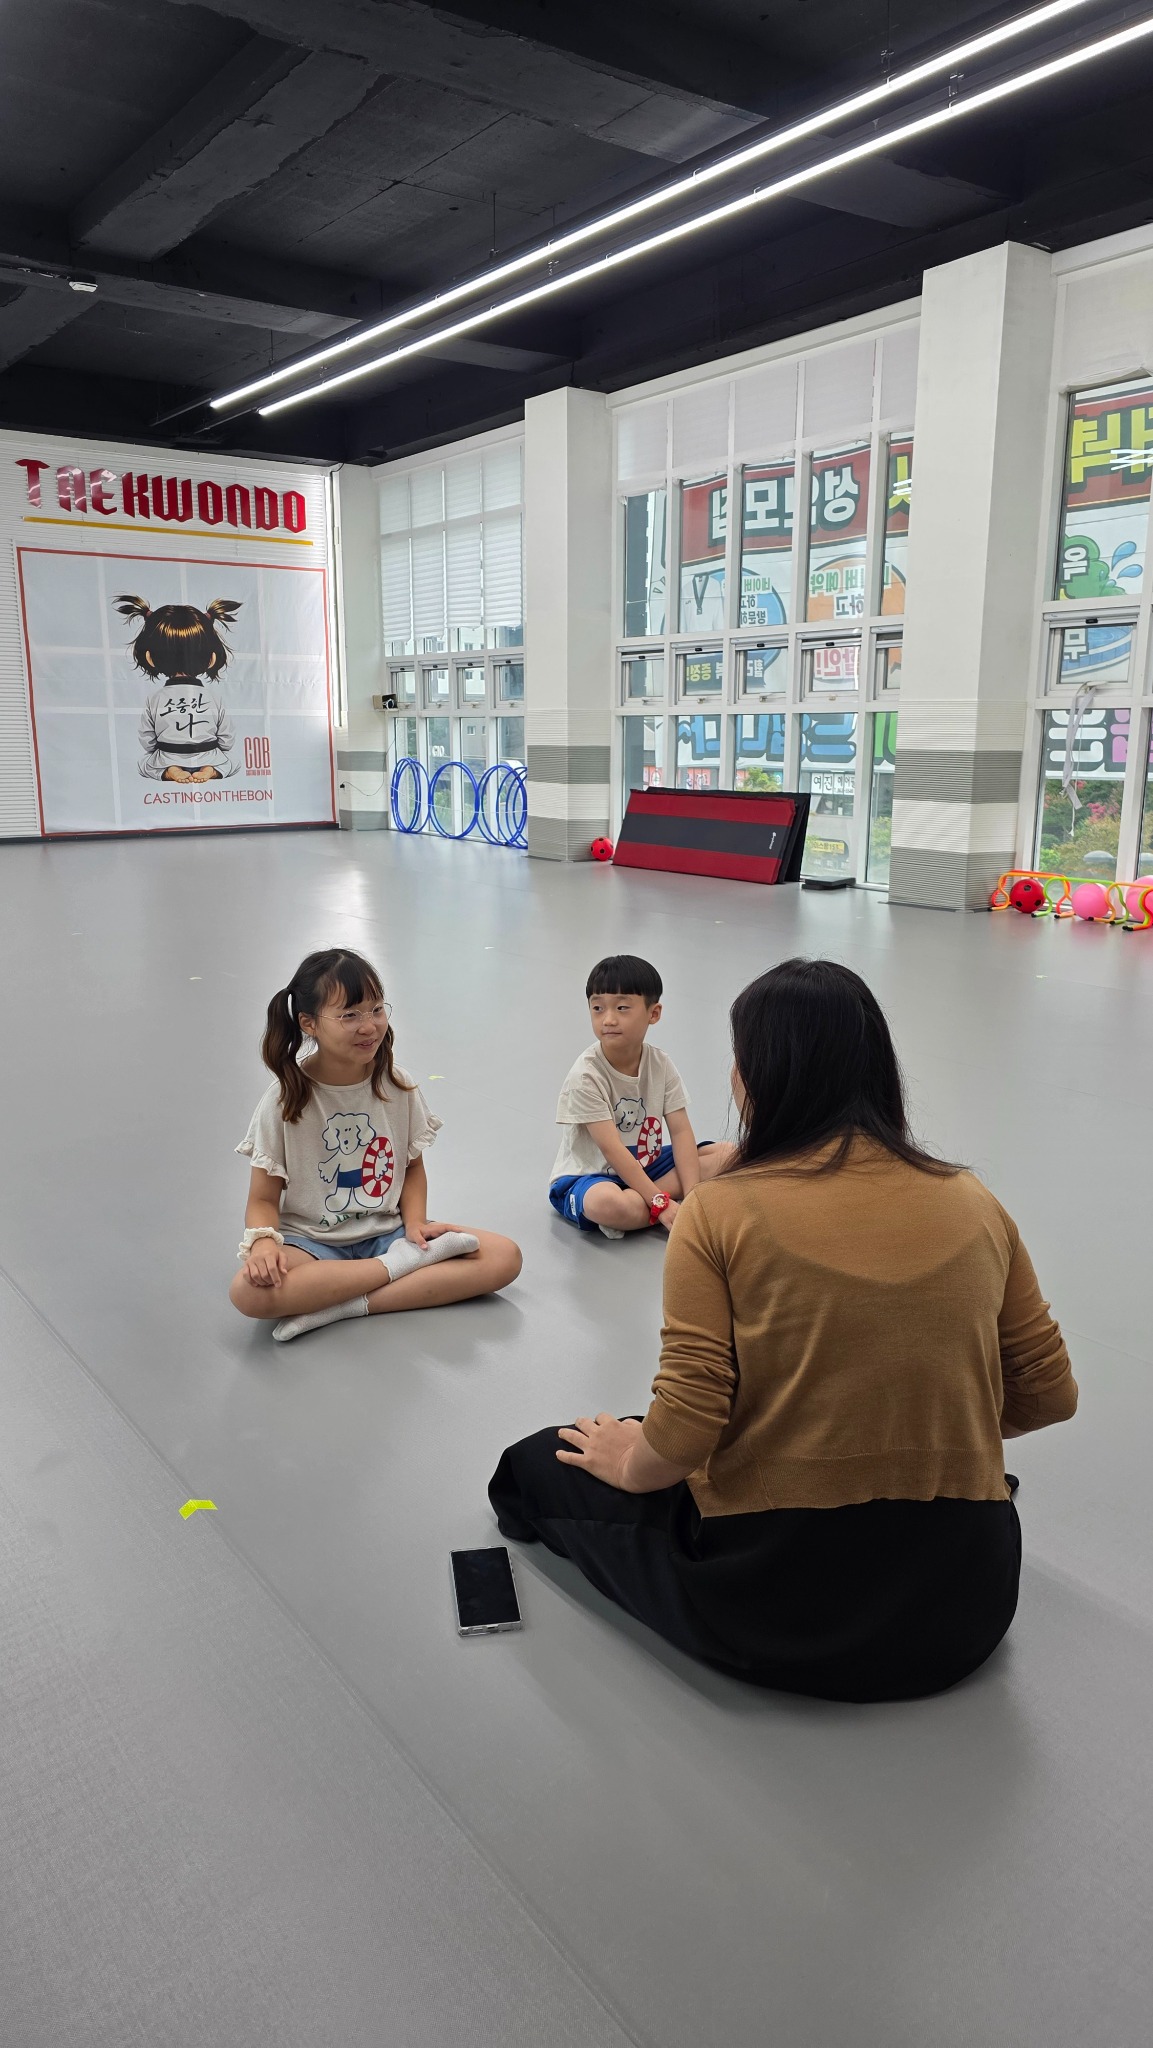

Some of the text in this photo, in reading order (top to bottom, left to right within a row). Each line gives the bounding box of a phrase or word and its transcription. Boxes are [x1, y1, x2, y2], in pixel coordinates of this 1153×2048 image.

[15, 458, 307, 533] TAEKWONDO
[160, 693, 211, 717] 소중한
[175, 712, 210, 738] 나
[244, 736, 271, 769] COB
[143, 789, 273, 805] CASTINGONTHEBON
